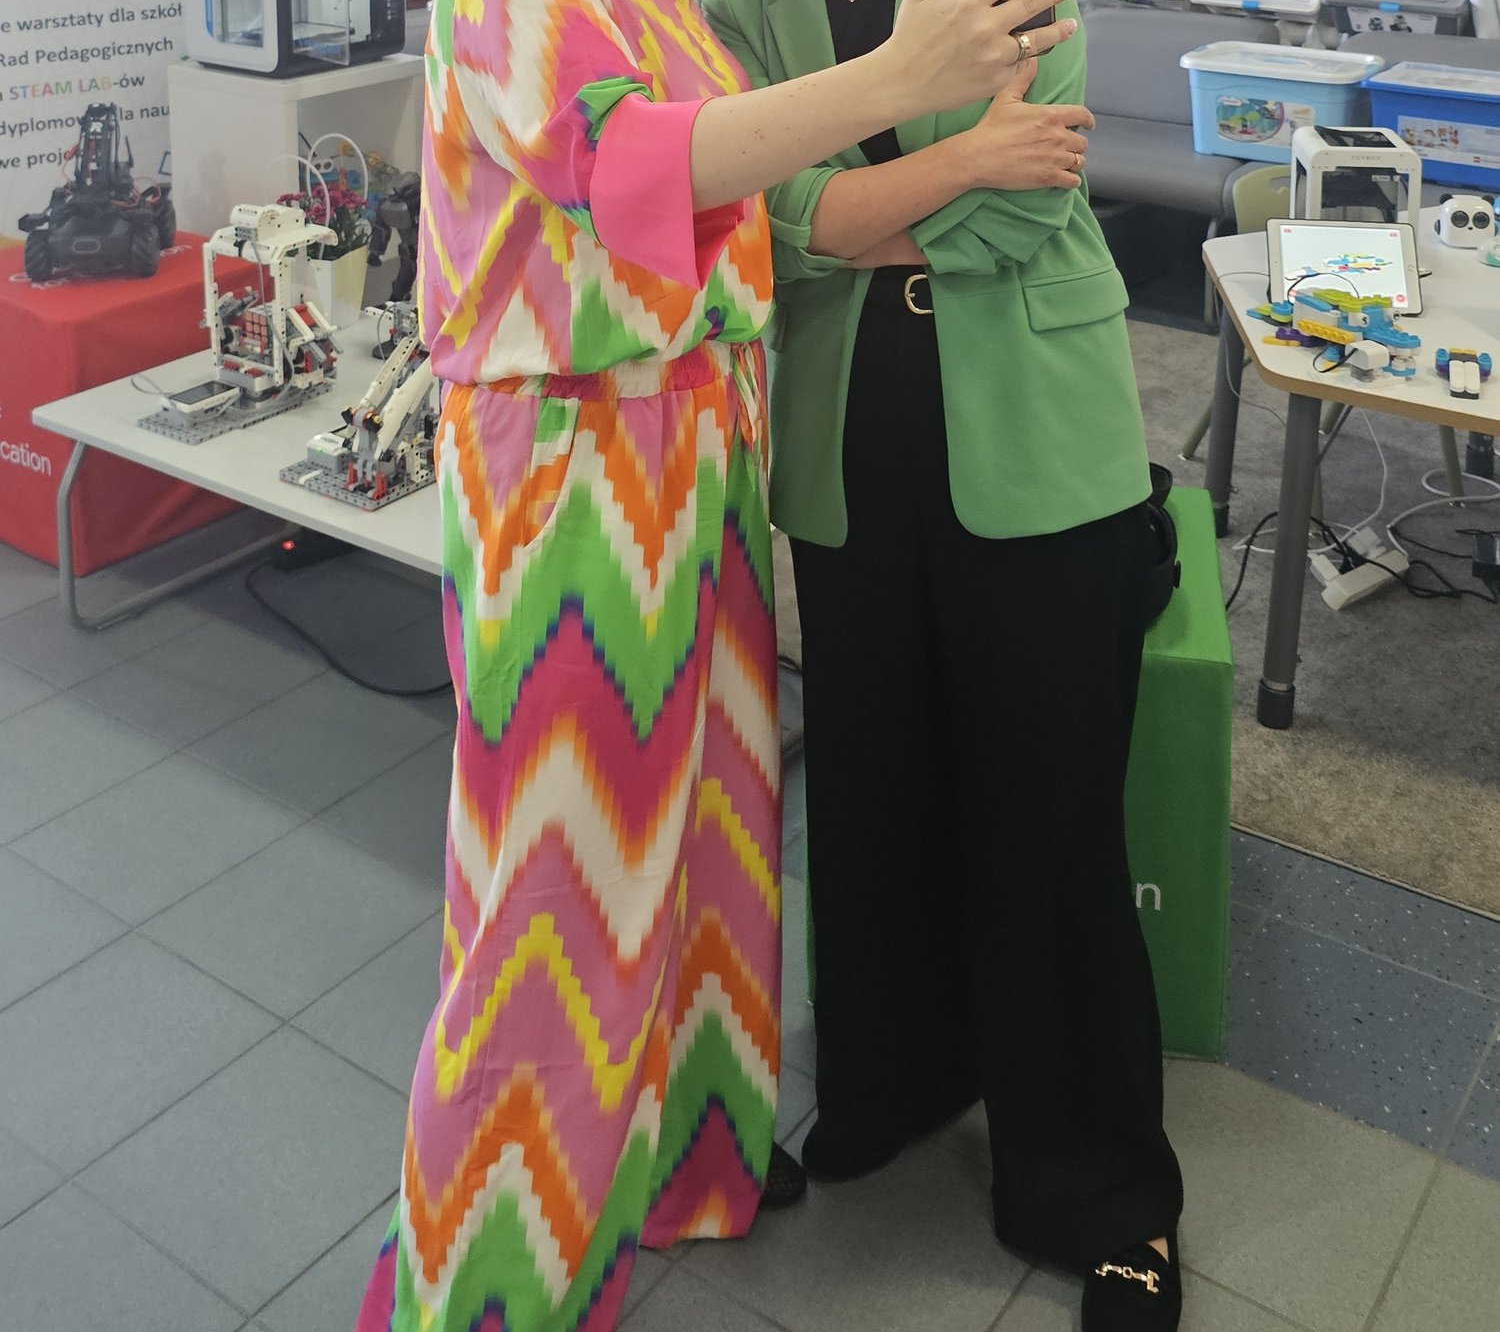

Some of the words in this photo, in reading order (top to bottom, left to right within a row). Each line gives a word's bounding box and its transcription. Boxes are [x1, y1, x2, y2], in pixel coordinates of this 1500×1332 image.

[0, 21, 11, 34] e
[17, 11, 104, 30] warsztaty
[109, 7, 135, 23] dla
[140, 2, 183, 21] szkół
[0, 49, 29, 68] Rad
[35, 36, 174, 64] Pedagogicznych
[10, 81, 73, 100] STEAM
[78, 74, 146, 94] LAB-ów
[27, 147, 66, 169] proj
[0, 440, 52, 477] cation
